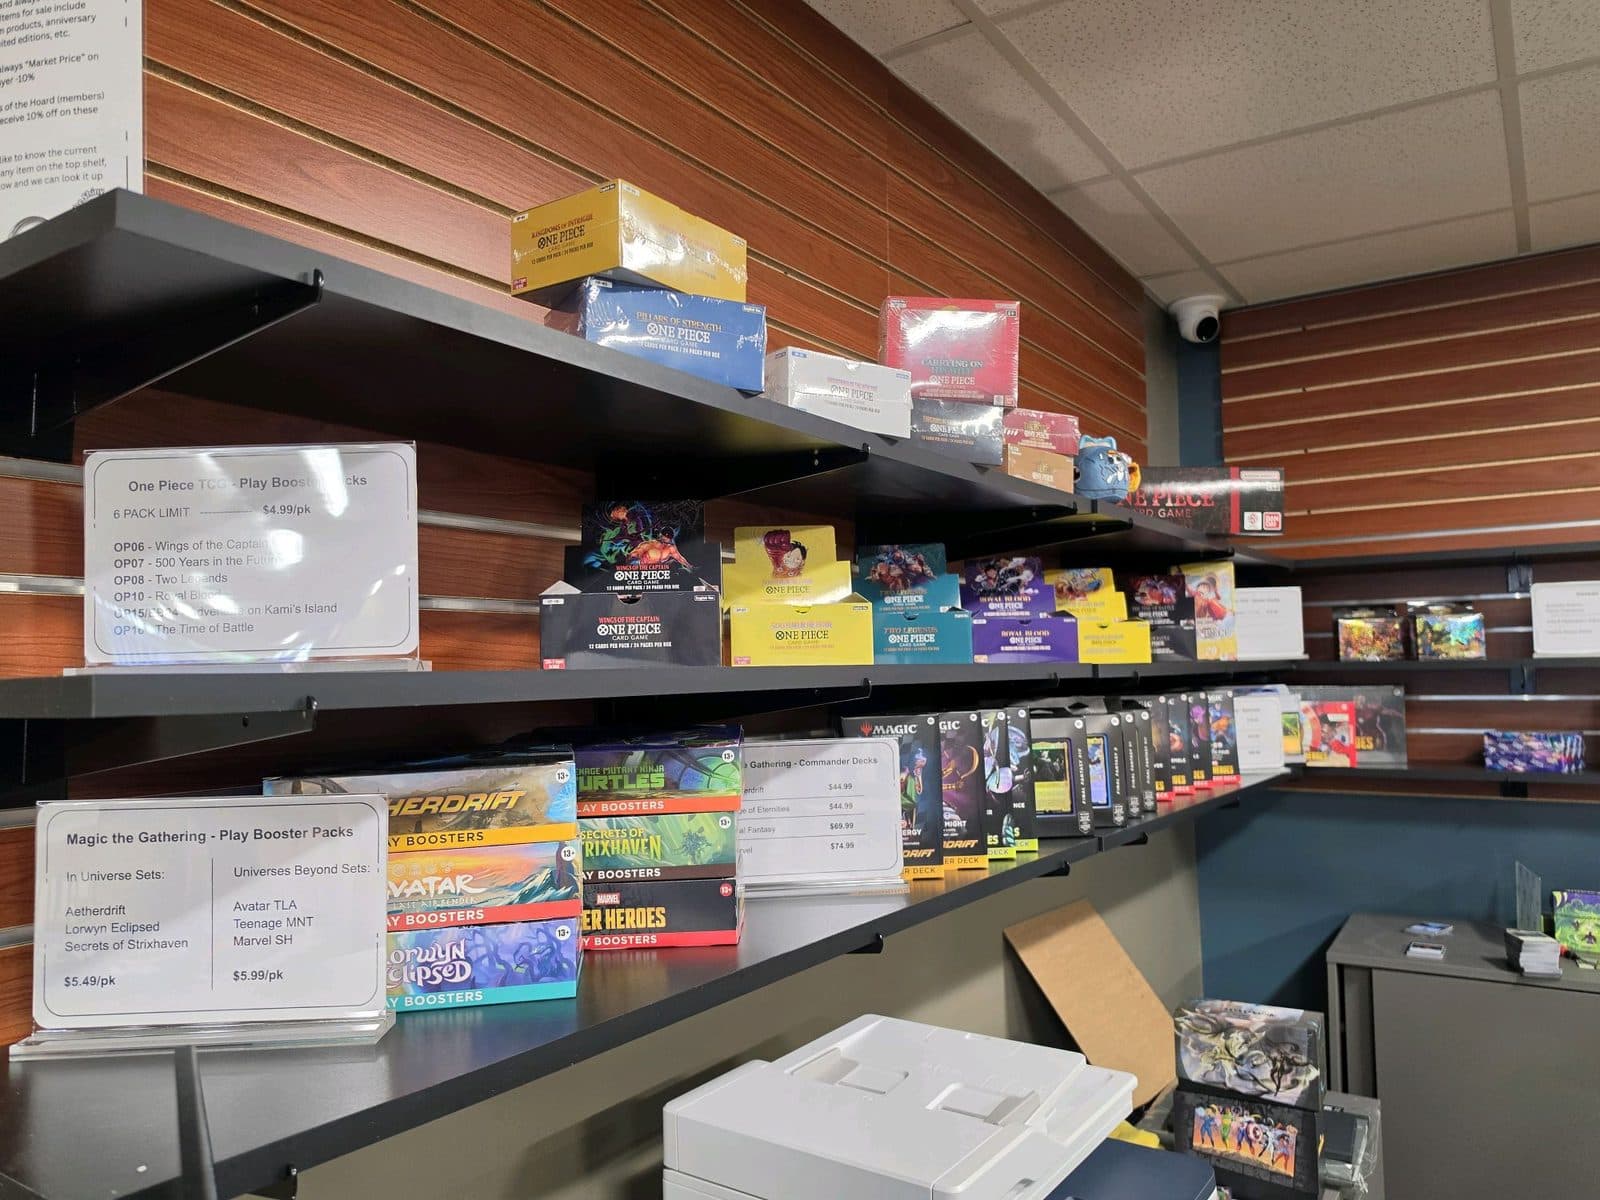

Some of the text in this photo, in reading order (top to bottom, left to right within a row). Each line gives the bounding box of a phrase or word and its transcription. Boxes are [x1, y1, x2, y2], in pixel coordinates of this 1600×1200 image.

[22, 1, 86, 17] for sale include
[6, 20, 44, 34] products,
[45, 14, 97, 26] anniversary
[18, 30, 70, 44] editions, etc.
[4, 90, 105, 111] of the Hoard (members)
[27, 106, 98, 120] 10% off on these
[14, 146, 97, 162] to know the current
[0, 158, 107, 176] any item on the top shelf,
[14, 172, 103, 188] and we can look up
[538, 224, 585, 250] ONE PIECE
[636, 311, 722, 332] PILLARS OF STRENGTH
[646, 322, 711, 344] ONE PIECE
[928, 374, 976, 385] ONE PIECE
[128, 480, 154, 492] One
[159, 480, 194, 490] Piece
[240, 477, 268, 490] Play
[1152, 485, 1216, 507] PIECE
[114, 504, 312, 519] 6 PACK LIMIT $4.99/pk
[1158, 508, 1192, 519] GAME
[114, 542, 145, 552] OP06
[155, 540, 189, 552] Wings
[192, 540, 203, 550] of
[206, 540, 223, 550] the
[114, 556, 243, 568] OP07 500 Years in the
[114, 574, 178, 585] OP08 Two
[614, 570, 670, 581] ONE PIECE
[766, 586, 810, 594] ONE PIECE
[114, 592, 144, 602] OP10
[884, 596, 902, 604] ONE
[248, 603, 338, 615] on Kami's Island
[156, 622, 254, 634] The Time of Battle
[596, 624, 662, 636] ONE PIECE
[776, 630, 829, 640] ONE PIECE
[888, 634, 935, 644] ONE PIECE
[872, 724, 918, 734] MAGIC
[939, 720, 960, 730] GIC
[724, 752, 733, 760] 13+
[750, 757, 878, 769] Gathering Commander Decks
[603, 764, 664, 775] MUTANT NINJA
[557, 772, 570, 780] 13+
[577, 773, 664, 790] URTLES
[828, 783, 853, 791] $44.99
[601, 800, 664, 812] BOOSTERS
[748, 802, 853, 814] of Eternities $44.99
[581, 828, 644, 840] SECRETS OF
[748, 822, 854, 834] Fantasy $69.99
[67, 826, 354, 847] Magic the Gathering Play Booster Packs
[406, 832, 484, 846] BOOSTERS
[582, 834, 662, 860] RIXHAVEN
[830, 842, 854, 850] $74.99
[563, 850, 576, 858] 13+
[66, 870, 165, 882] In Universe Sets:
[234, 864, 370, 878] Universes Beyond Sets:
[598, 868, 661, 879] BOOSTERS
[388, 874, 488, 898] VATAR
[596, 894, 620, 904] MARVEL
[65, 904, 126, 916] Aetherdrift
[233, 900, 298, 912] Avatar TLA
[234, 916, 314, 930] Teenage MNT
[406, 910, 484, 924] BOOSTERS
[606, 907, 666, 929] HEROES
[65, 922, 160, 936] Lorwyn Eclipsed
[558, 928, 570, 937] 13+
[64, 938, 188, 952] Secrets of Strixhaven
[233, 934, 293, 946] Marvel SH
[594, 936, 657, 946] BOOSTERS
[64, 976, 116, 988] $5.49/pk
[233, 970, 284, 982] $5.99/pk
[404, 991, 484, 1007] BOOSTERS
